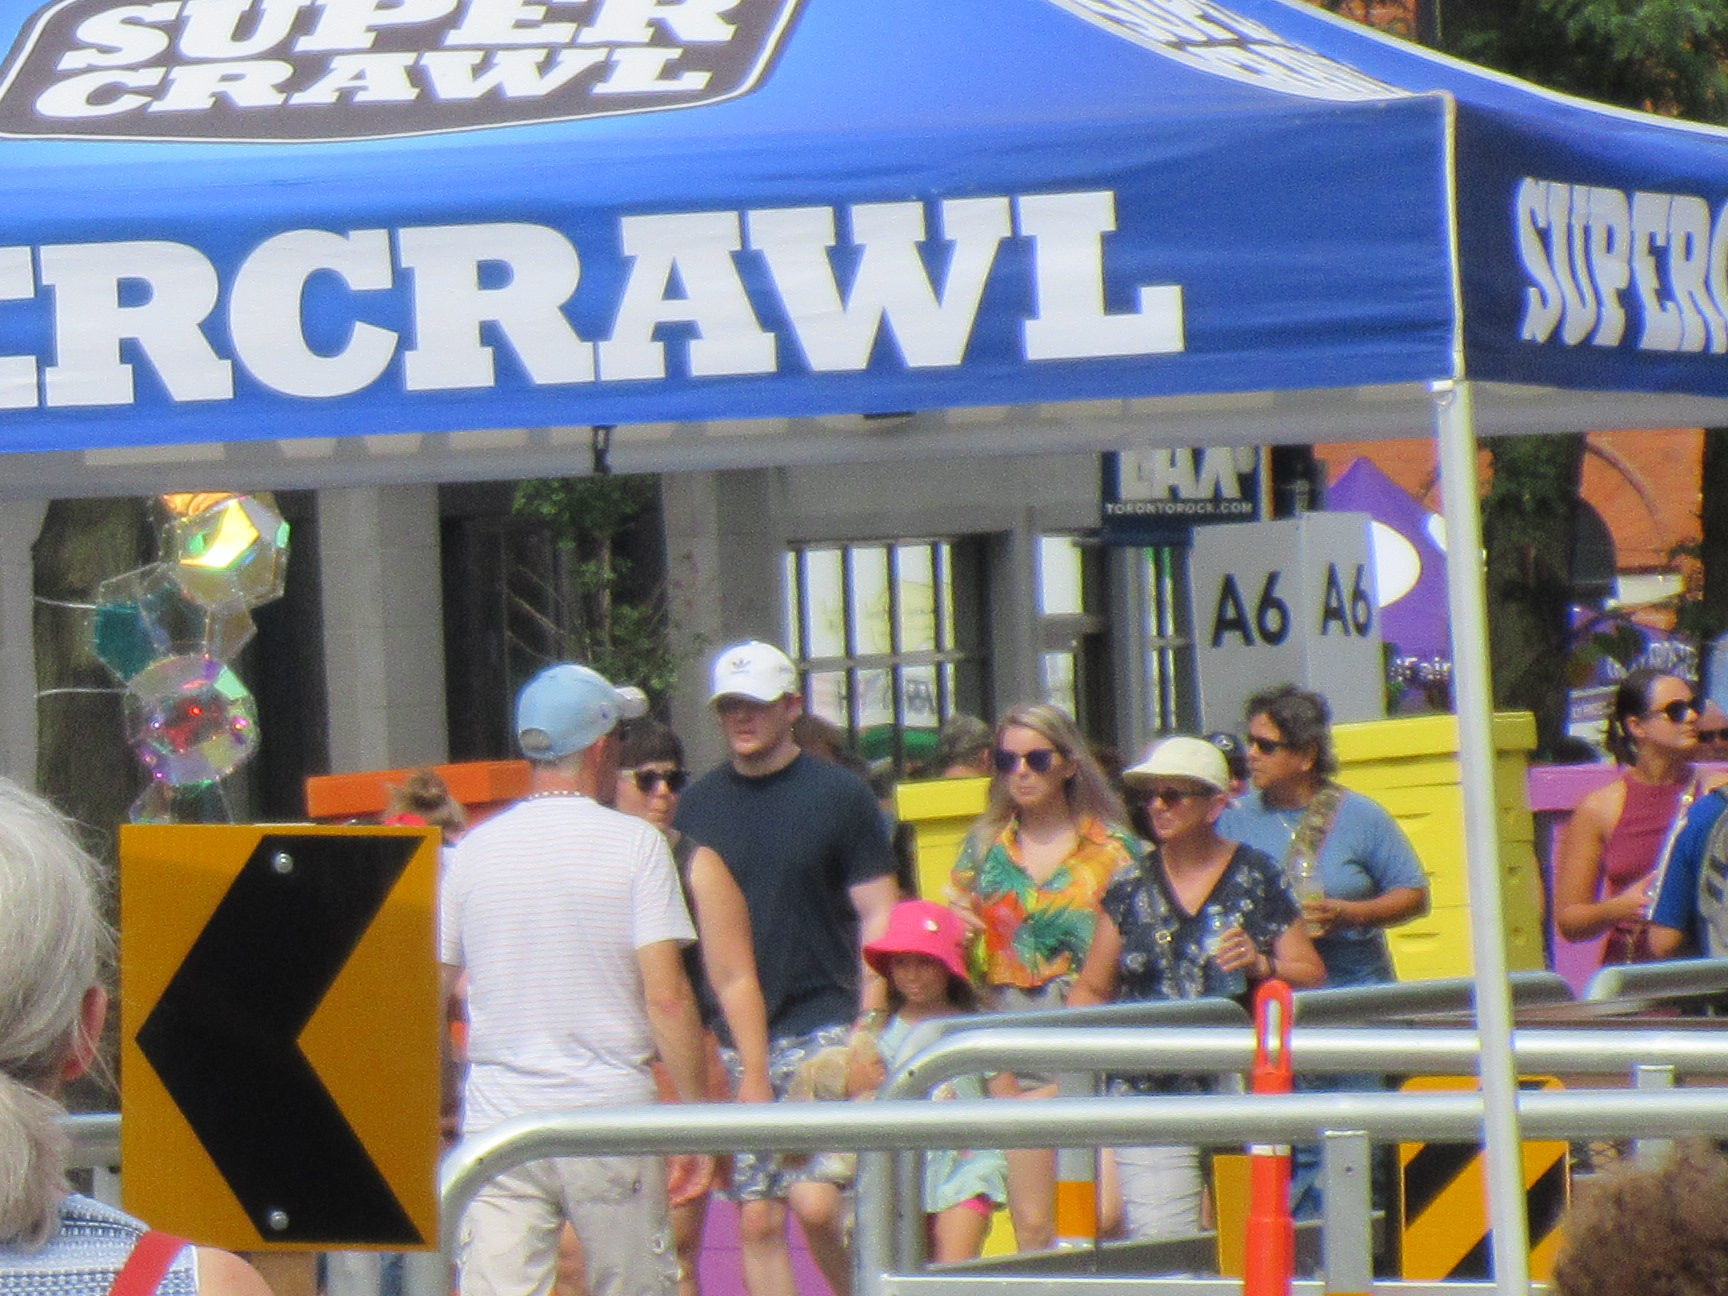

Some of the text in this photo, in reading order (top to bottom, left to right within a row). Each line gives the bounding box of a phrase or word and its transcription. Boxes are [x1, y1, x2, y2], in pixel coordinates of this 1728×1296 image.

[35, 47, 712, 118] CRAWL
[1211, 571, 1291, 648] A6
[1321, 562, 1373, 638] A6
